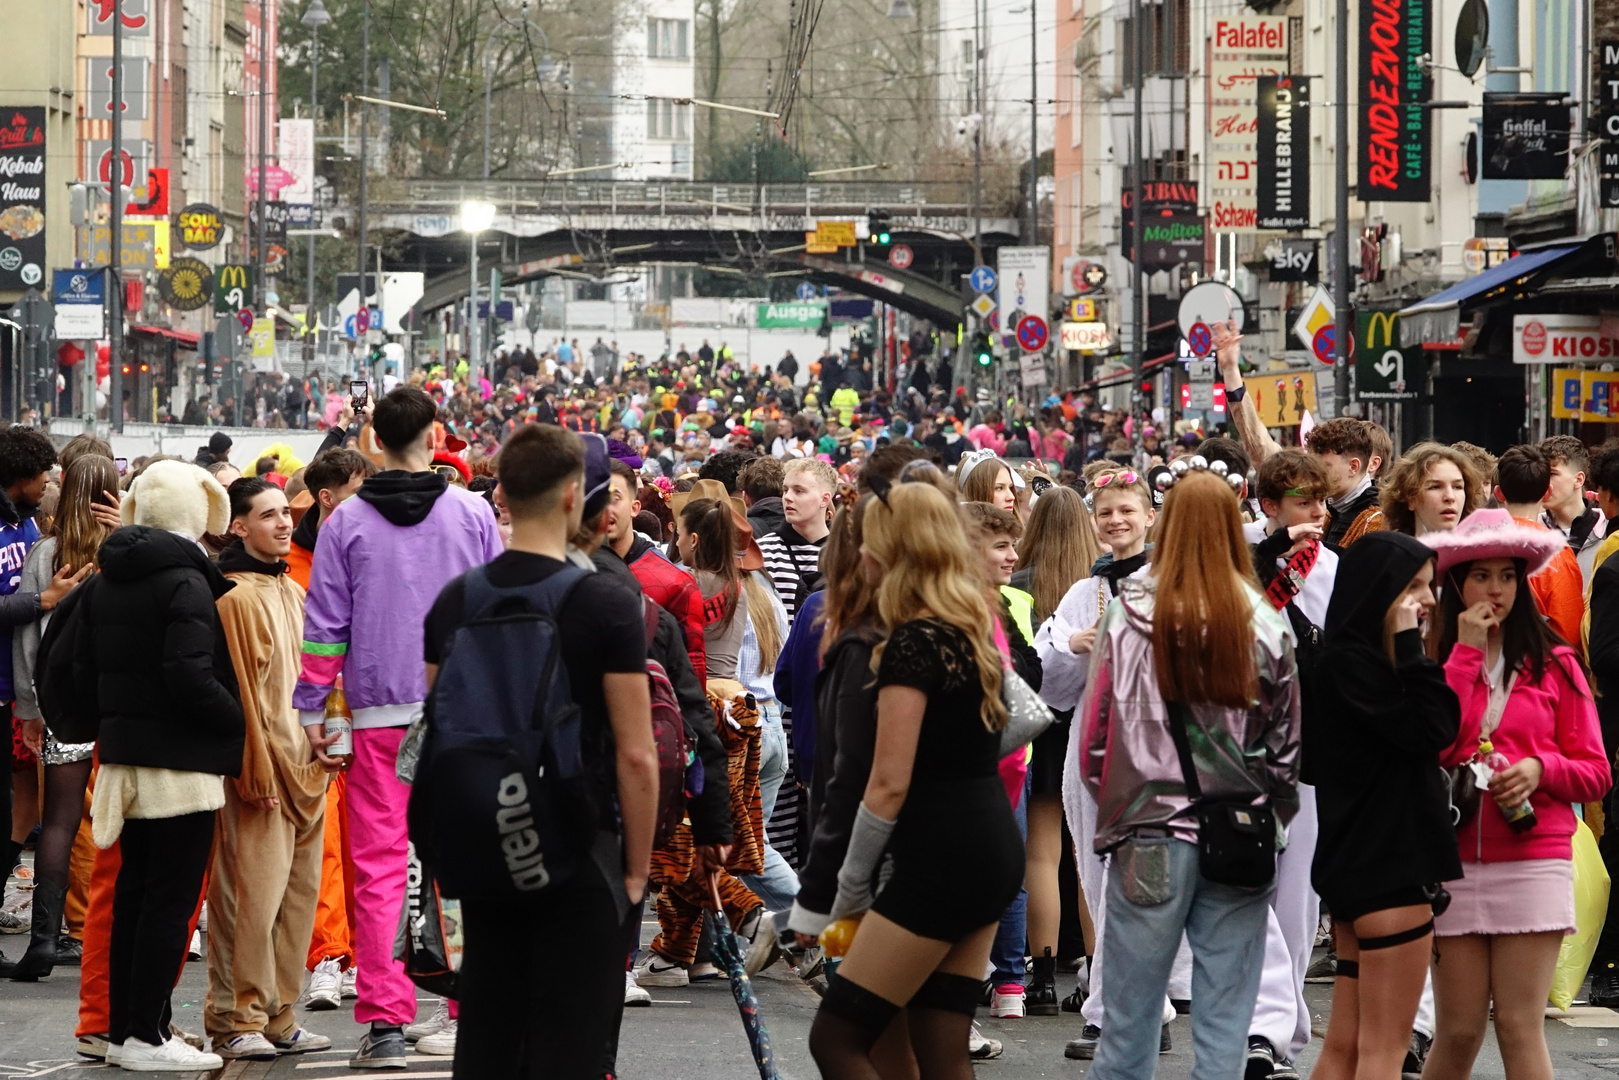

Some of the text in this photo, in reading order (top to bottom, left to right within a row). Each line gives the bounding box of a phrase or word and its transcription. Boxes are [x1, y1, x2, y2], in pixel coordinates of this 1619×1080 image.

[1216, 21, 1283, 48] Falafel
[0, 155, 43, 178] Kebab
[1405, 143, 1422, 178] CAFÉ
[1, 182, 41, 201] Haus
[179, 213, 222, 229] SOUL
[183, 228, 216, 243] BAR
[1143, 223, 1203, 242] Mojitos
[1274, 245, 1314, 272] sky
[1061, 329, 1112, 345] KIOSK
[496, 772, 550, 891] arena
